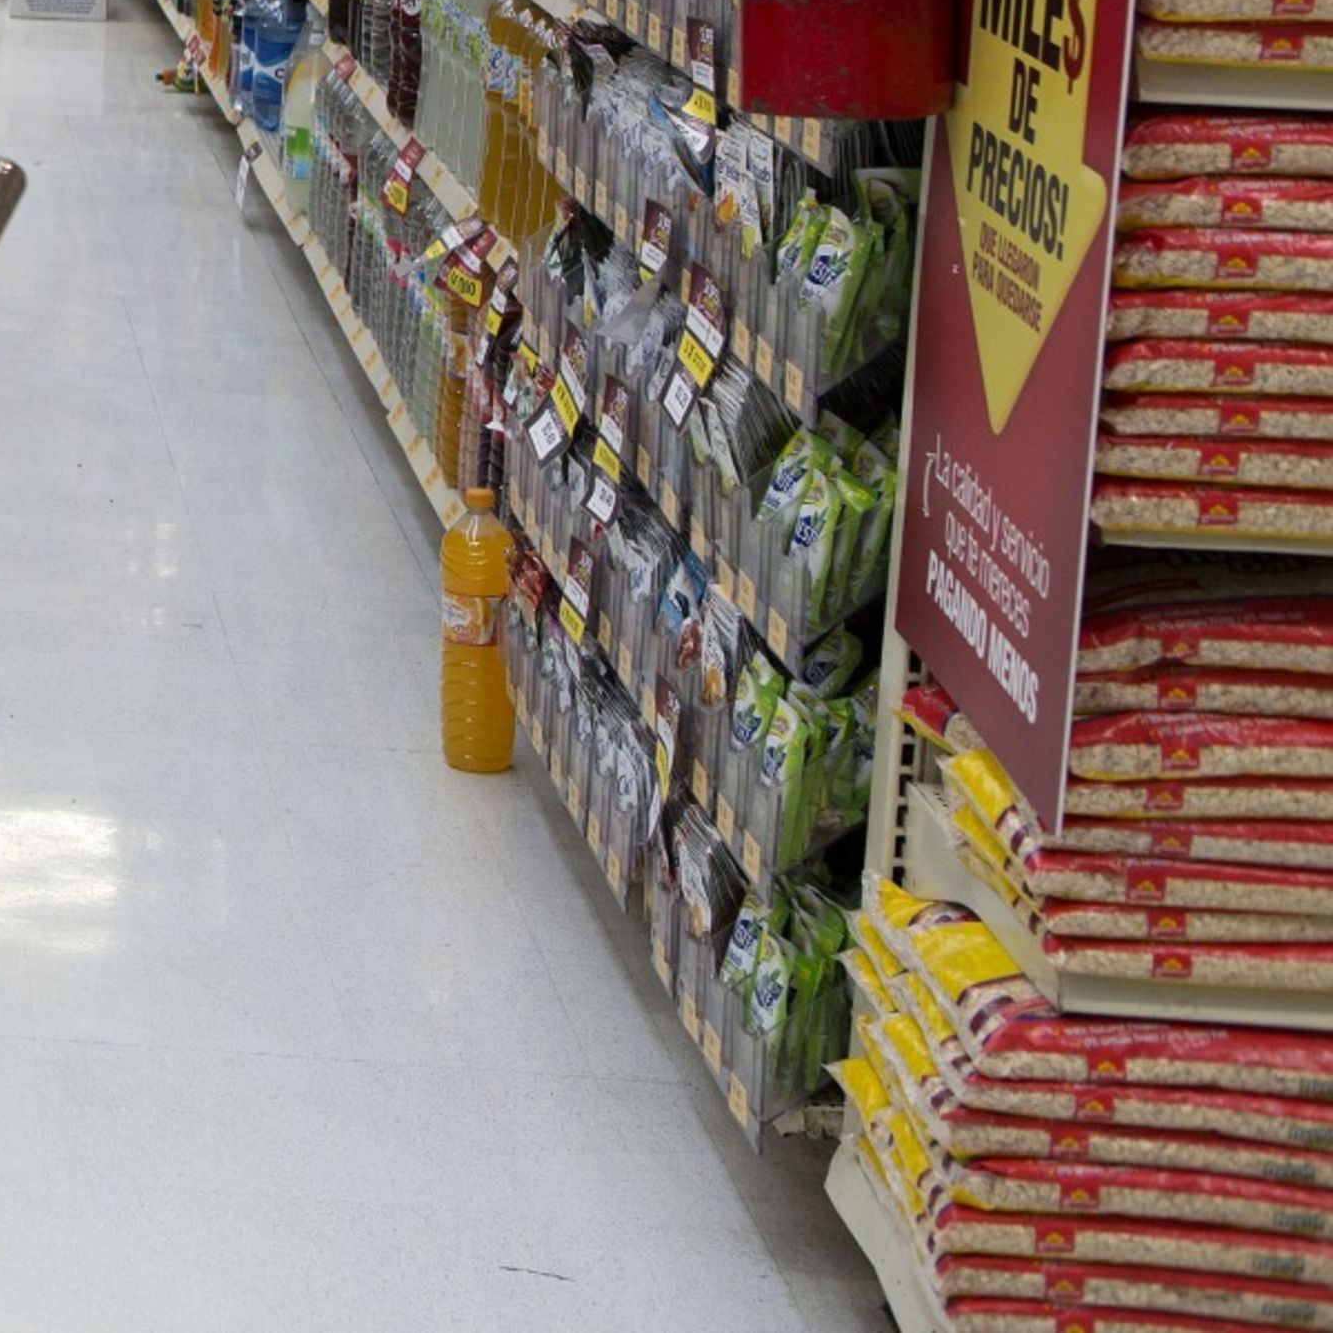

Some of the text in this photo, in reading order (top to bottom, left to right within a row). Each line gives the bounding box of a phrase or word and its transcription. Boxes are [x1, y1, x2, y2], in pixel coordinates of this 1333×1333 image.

[1008, 57, 1040, 144] DE
[966, 121, 1071, 262] PRECIOS!
[979, 220, 997, 258] QUE
[972, 249, 1042, 333] PARA QUEDARSE
[935, 433, 950, 491] La
[949, 454, 992, 533] calidad
[1001, 513, 1050, 599] servicio
[944, 509, 1031, 640] que te mereces
[926, 549, 1039, 725] PAGANDO MENOS
